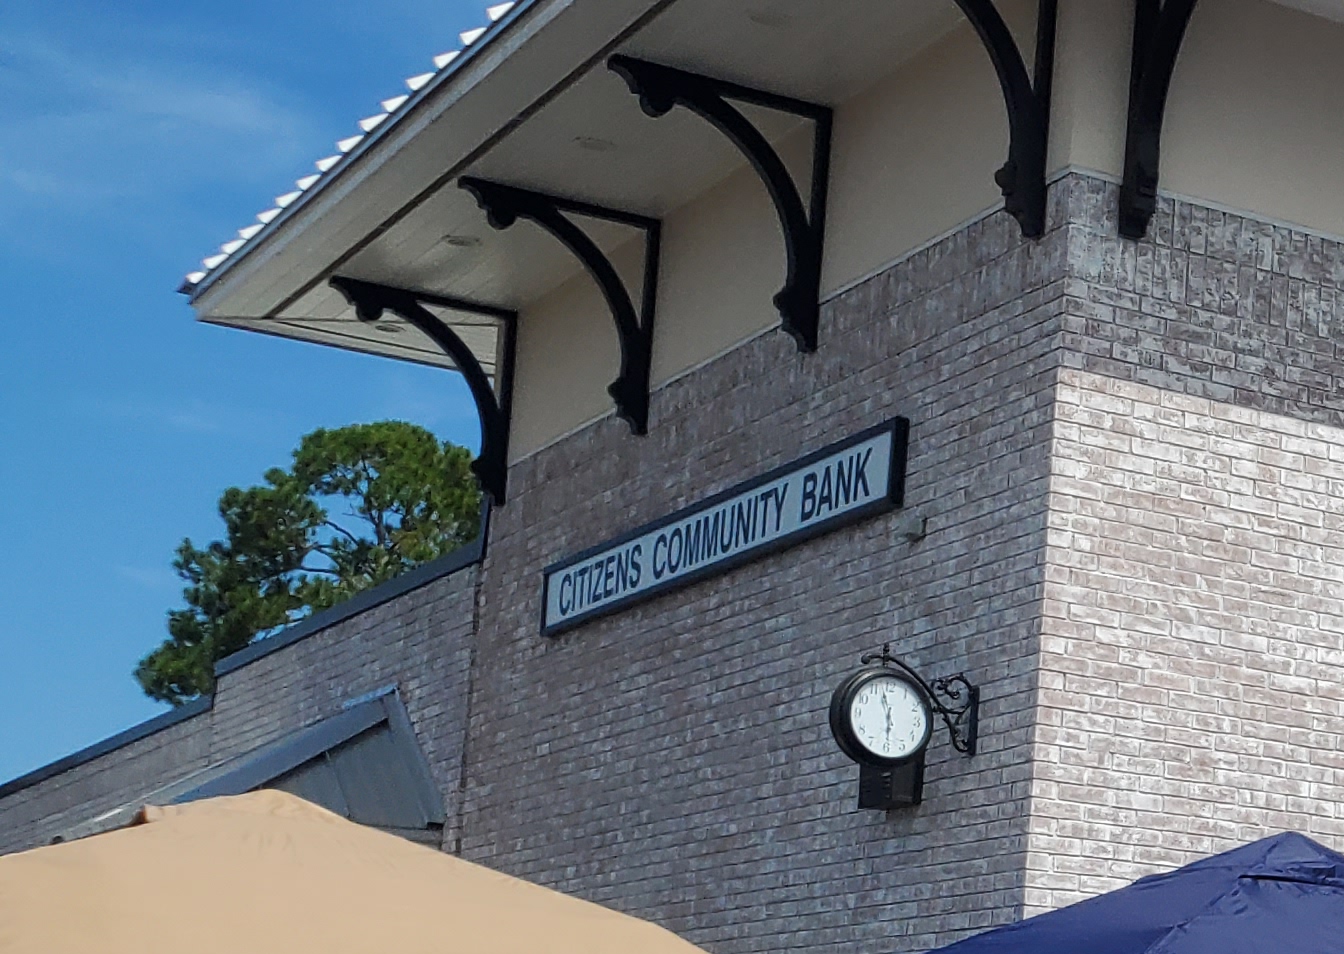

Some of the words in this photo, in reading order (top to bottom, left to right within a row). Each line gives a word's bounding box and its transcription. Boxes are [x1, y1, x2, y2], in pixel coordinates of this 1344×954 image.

[558, 543, 643, 617] CITIZENS
[652, 481, 790, 581] COMMUNITY
[799, 446, 874, 523] BANK
